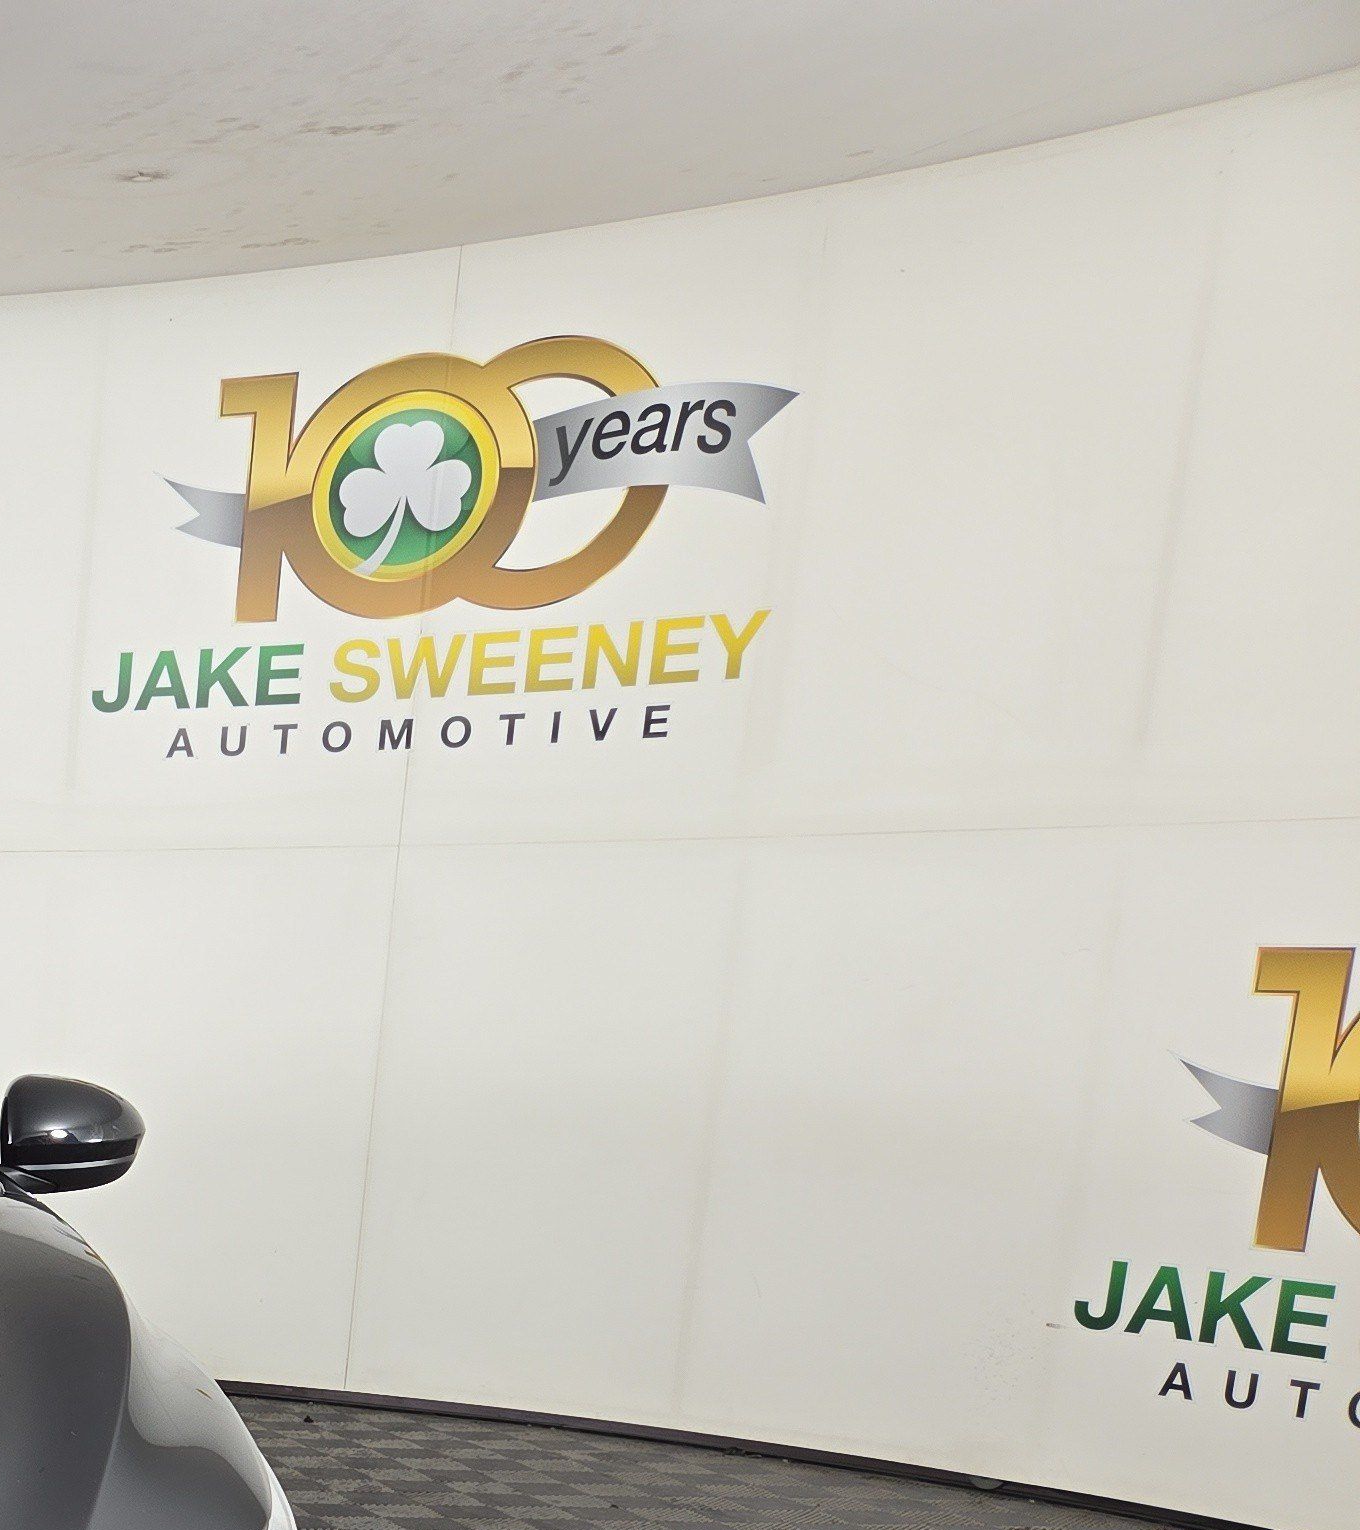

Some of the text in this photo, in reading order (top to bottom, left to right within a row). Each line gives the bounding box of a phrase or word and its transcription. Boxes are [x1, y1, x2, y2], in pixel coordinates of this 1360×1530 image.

[219, 334, 737, 623] 100 years
[91, 609, 771, 714] JAKE SWEENEY
[166, 704, 671, 760] AUTOMOTIVE
[1074, 1260, 1337, 1361] JAKE
